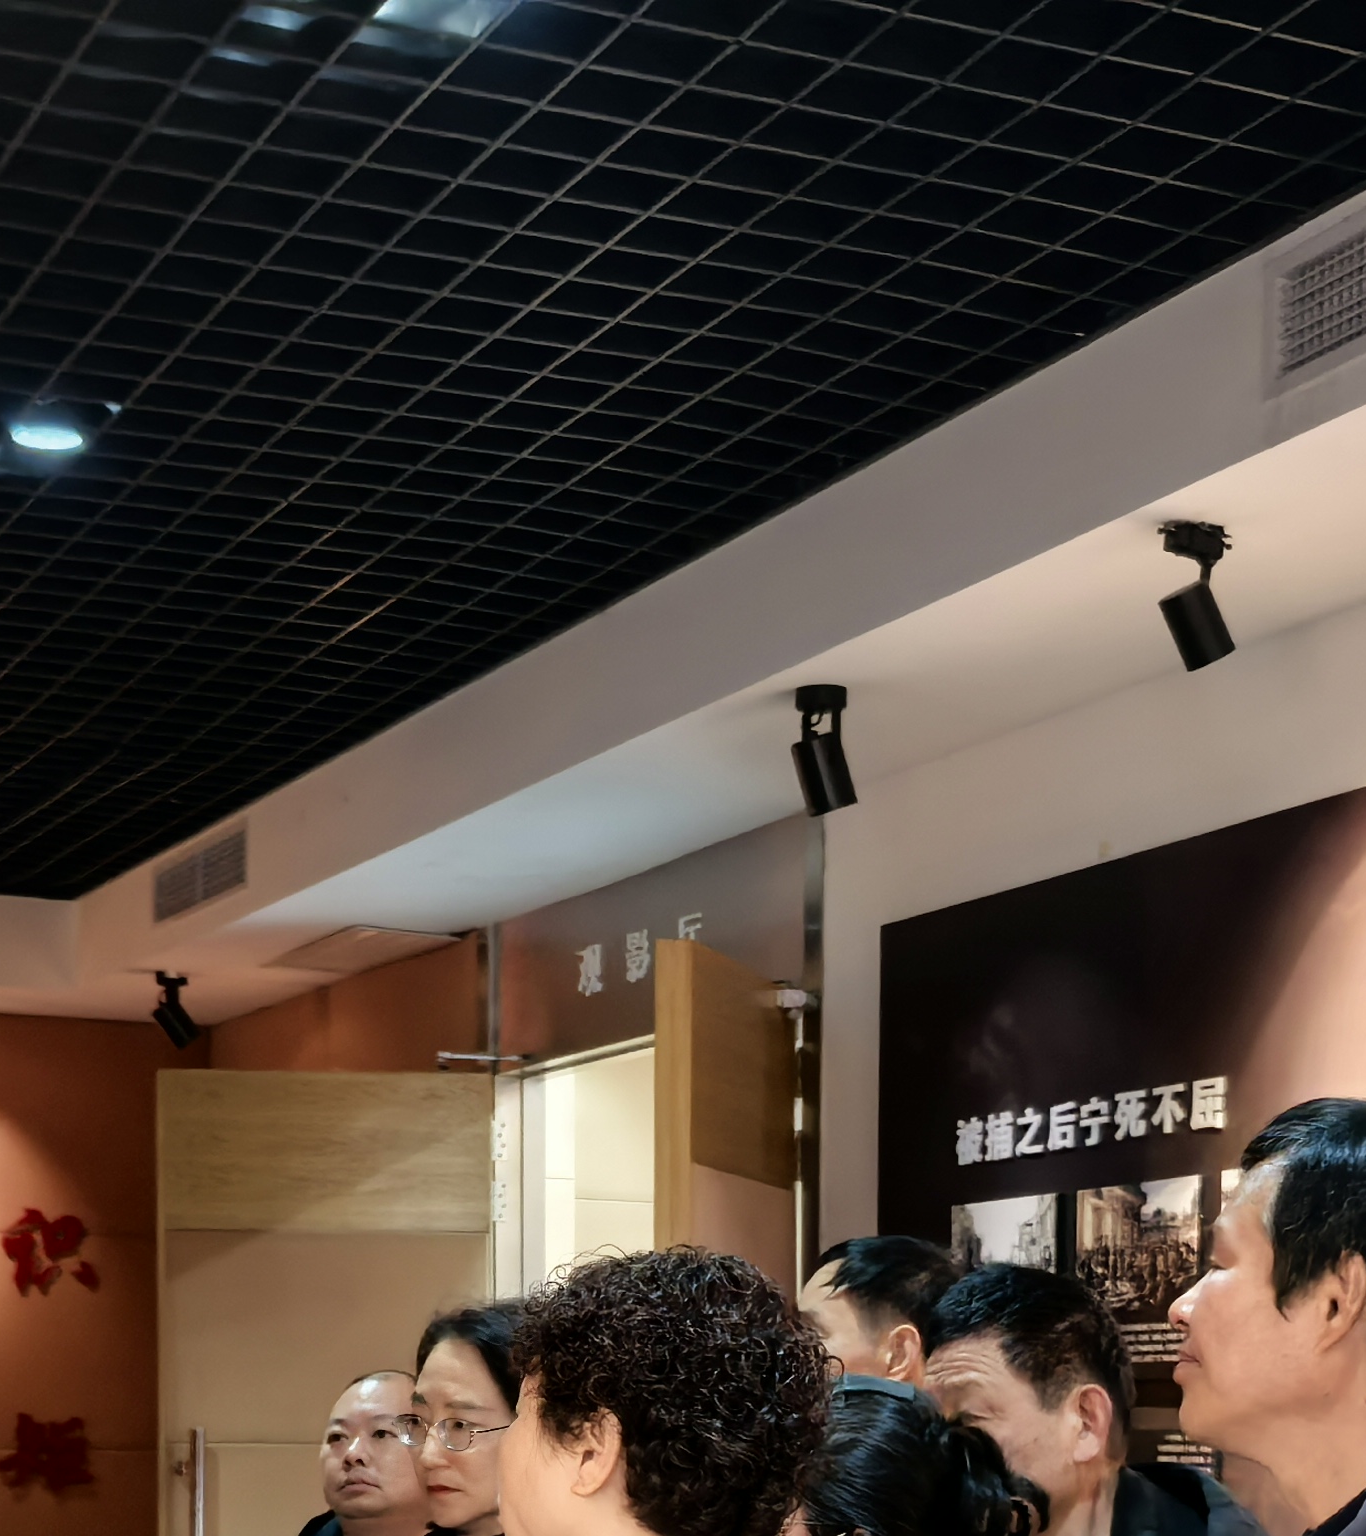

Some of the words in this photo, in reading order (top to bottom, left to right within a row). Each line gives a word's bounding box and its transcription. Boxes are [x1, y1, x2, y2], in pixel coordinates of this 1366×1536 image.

[955, 1075, 1228, 1166] 被捕之后宁死不屈
